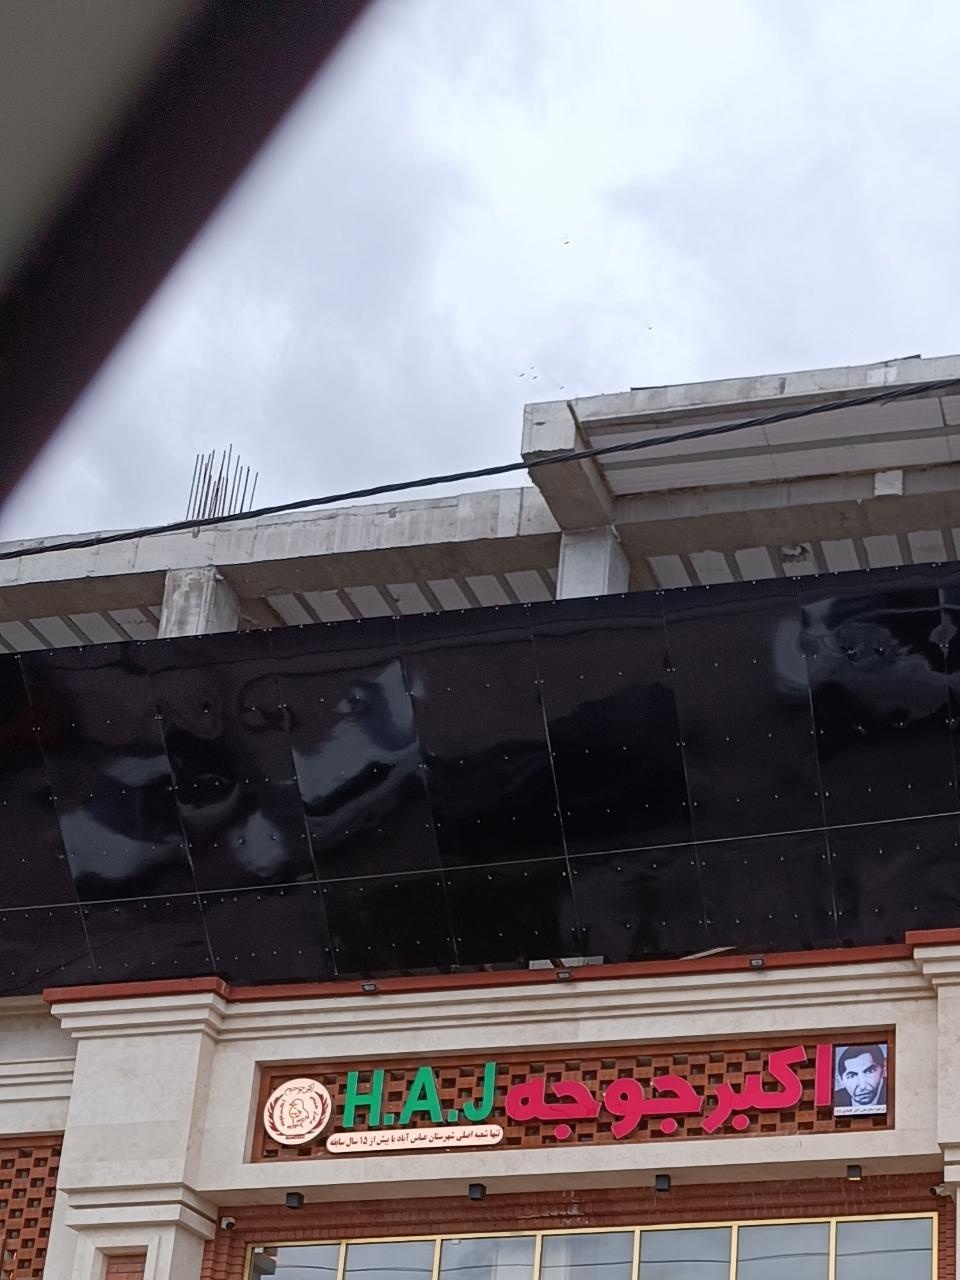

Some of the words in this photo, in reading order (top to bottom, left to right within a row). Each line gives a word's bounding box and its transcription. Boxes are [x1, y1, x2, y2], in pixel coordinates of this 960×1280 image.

[701, 1043, 833, 1134] اکبر
[342, 1061, 497, 1128] H.A.J
[504, 1074, 704, 1140] جوجه
[429, 1131, 455, 1142] شهرستان
[456, 1130, 473, 1141] اصلی
[475, 1129, 488, 1139] شعبه
[489, 1129, 501, 1138] تنها
[330, 1138, 345, 1148] سابقه
[346, 1136, 358, 1147] سال
[376, 1135, 390, 1145] بیش
